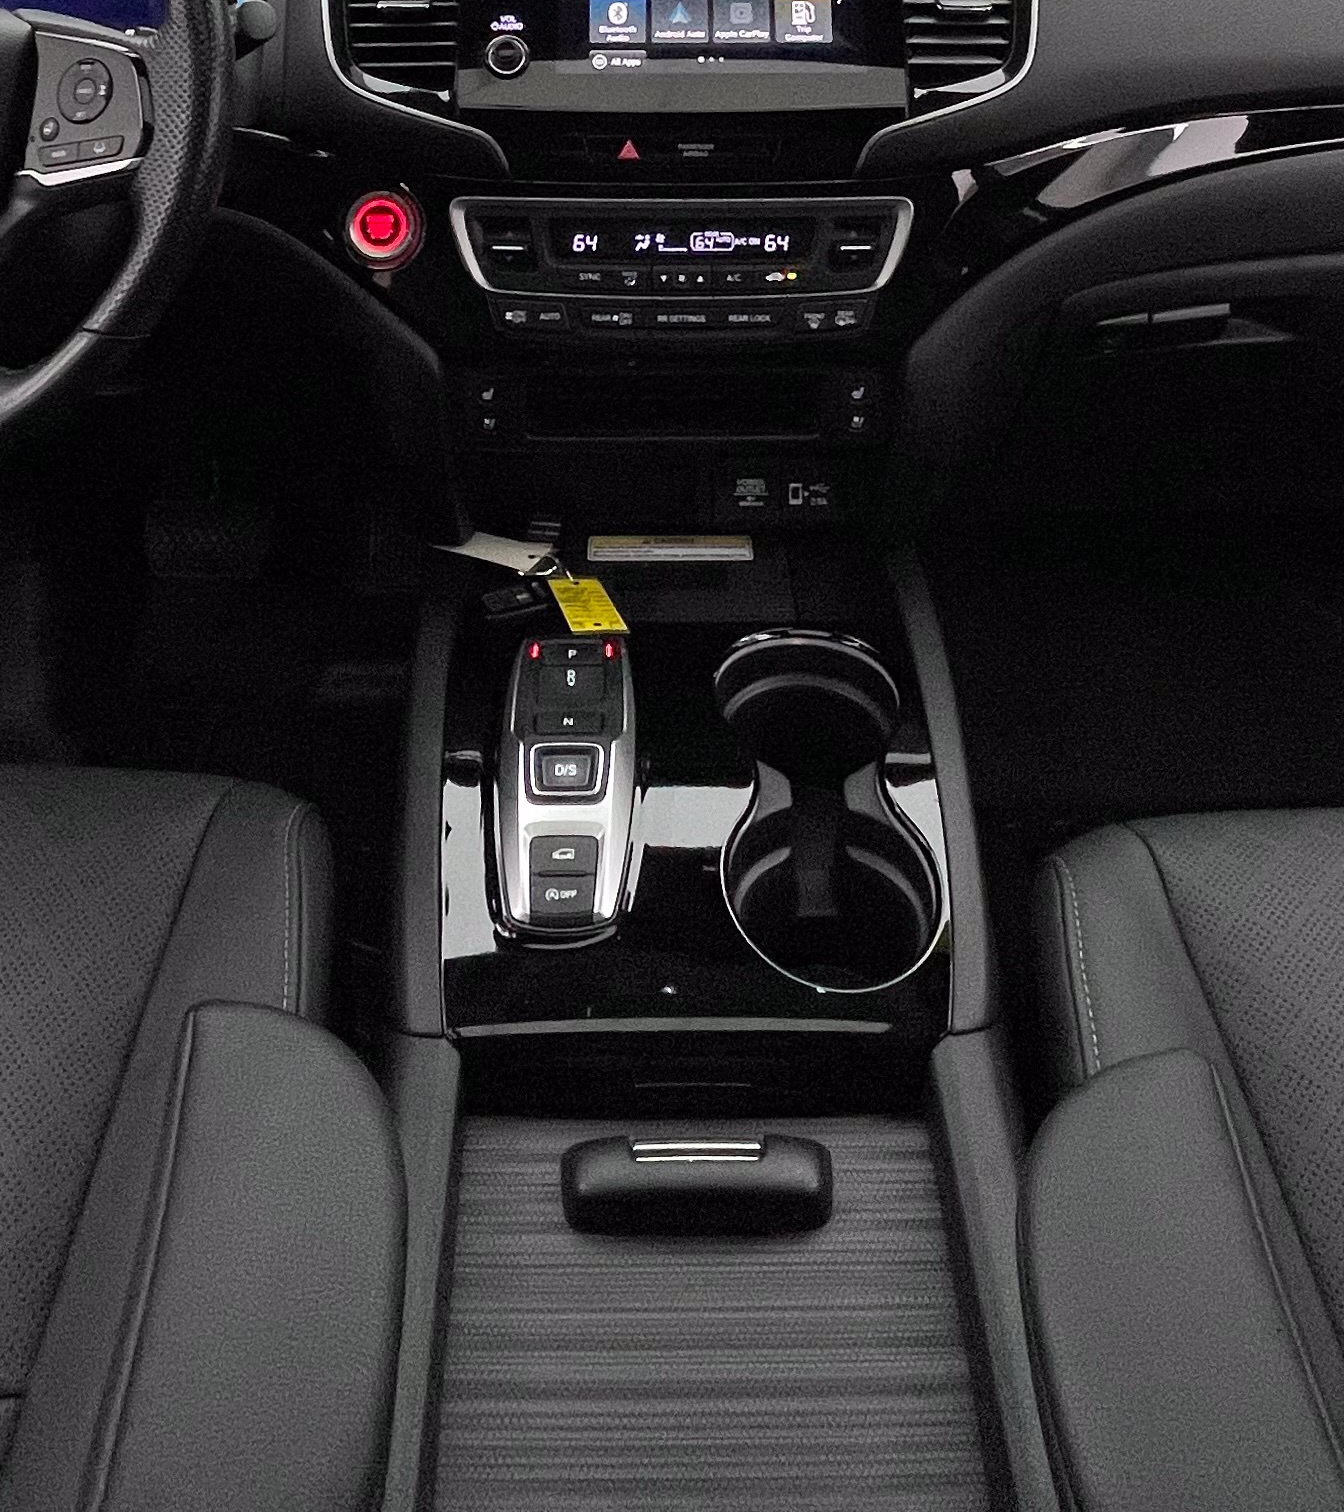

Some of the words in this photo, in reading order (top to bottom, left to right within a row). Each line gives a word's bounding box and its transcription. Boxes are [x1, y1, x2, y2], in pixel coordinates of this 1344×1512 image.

[572, 234, 599, 253] 64
[695, 237, 716, 250] 64
[764, 234, 790, 252] 64
[578, 272, 602, 281] SYNC
[539, 311, 561, 321] AUTO
[568, 649, 577, 659] P
[562, 717, 574, 726] N
[554, 763, 578, 776] D/S
